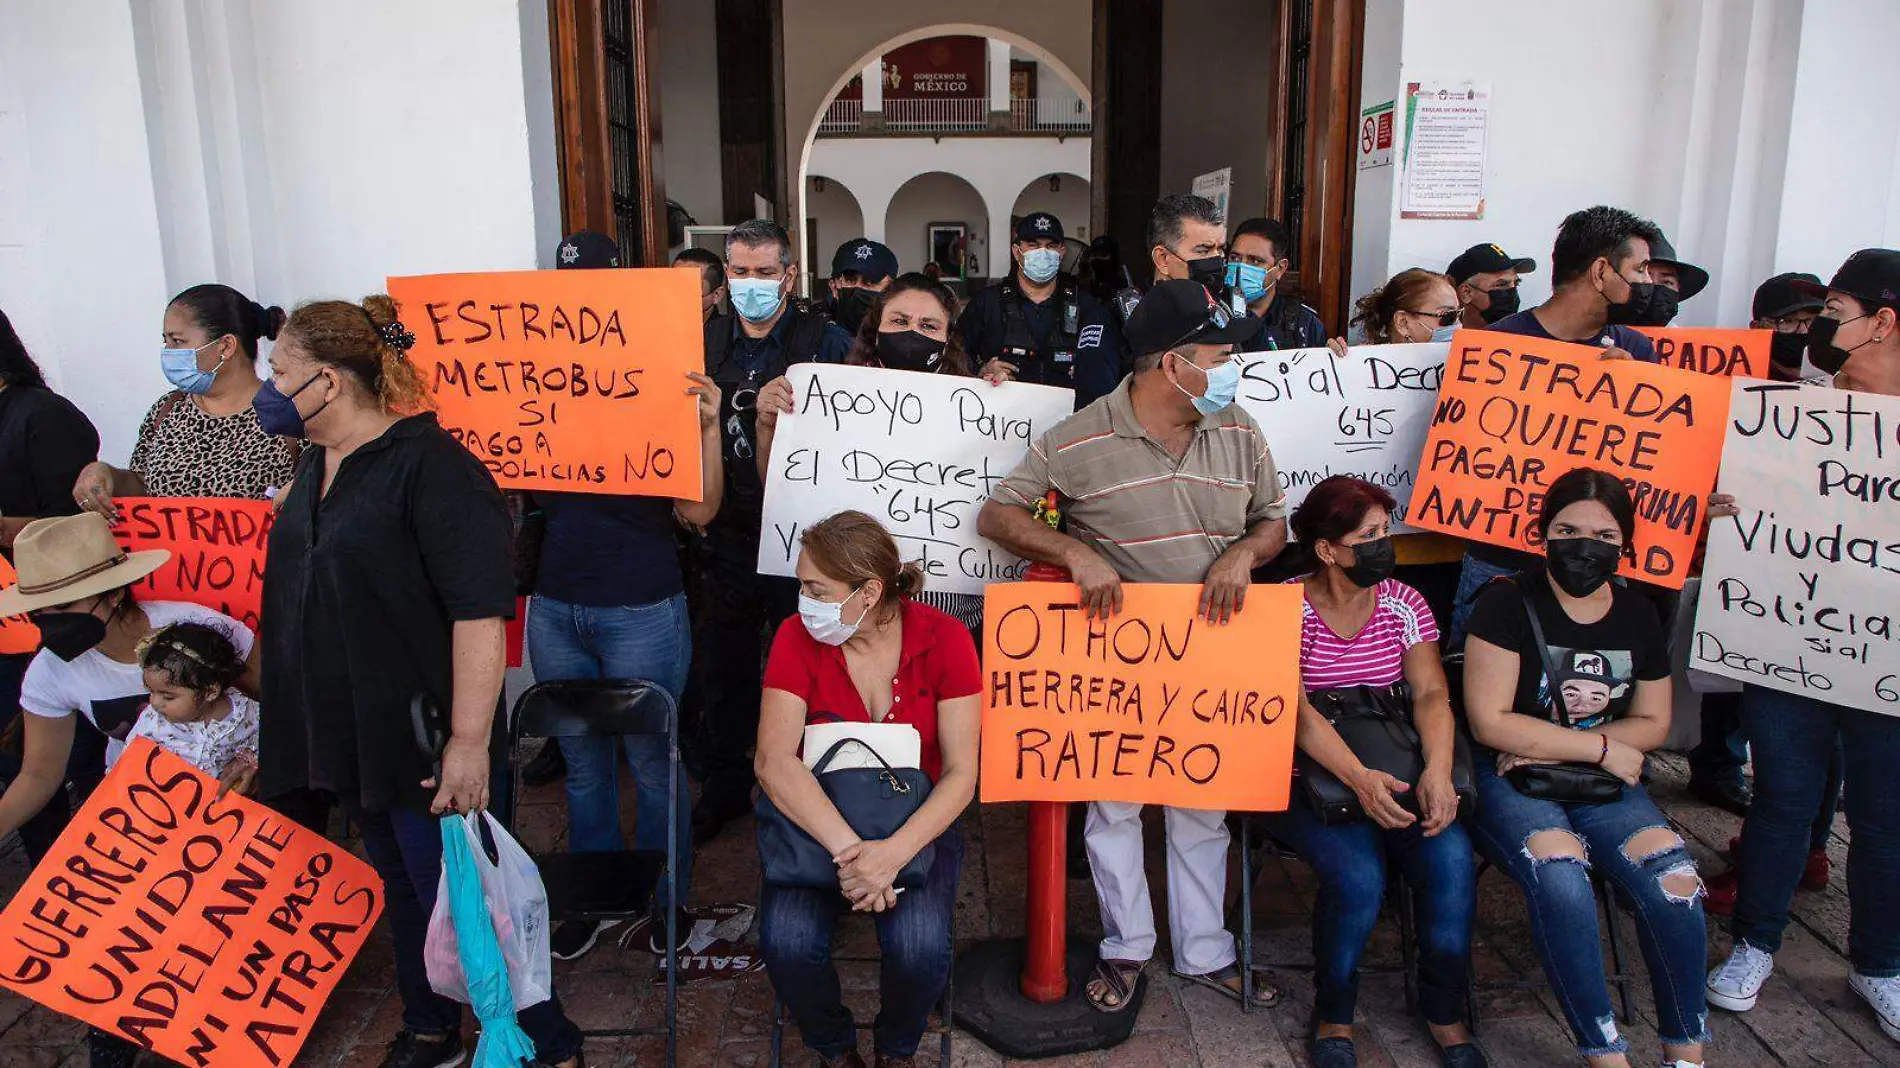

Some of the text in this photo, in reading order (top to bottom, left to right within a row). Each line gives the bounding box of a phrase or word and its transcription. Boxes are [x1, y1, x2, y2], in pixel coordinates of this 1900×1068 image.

[914, 80, 967, 91] MÉXICO
[425, 300, 627, 347] ESTRADA
[433, 359, 643, 399] METROBUS
[1309, 353, 1345, 399] al
[1364, 357, 1445, 392] Decr
[1648, 337, 1752, 376] RADA
[519, 400, 556, 426] SI
[802, 374, 1033, 447] Apoyo Para
[1456, 346, 1694, 427] ESTRADA
[536, 431, 552, 457] A
[1338, 406, 1396, 438] 645
[1432, 395, 1662, 471] NO QUIERE
[1734, 385, 1900, 459] Justi
[624, 441, 674, 483] NO
[784, 450, 1007, 496] El Decret
[1430, 439, 1549, 487] PAGAR
[176, 550, 235, 592] NO
[996, 603, 1193, 664] OTHON
[1718, 578, 1900, 641] Policia
[1696, 631, 1833, 690] Decreto
[990, 669, 1285, 726] HERRERA Y CAIRO
[1015, 728, 1221, 785] RATERO
[0, 746, 203, 984] GUERREROS
[63, 800, 245, 1005] UNIDOS
[221, 940, 275, 1001] UN
[267, 852, 333, 936] PASO
[116, 817, 296, 1050] ADELANTE
[245, 881, 375, 1067] ATRAS
